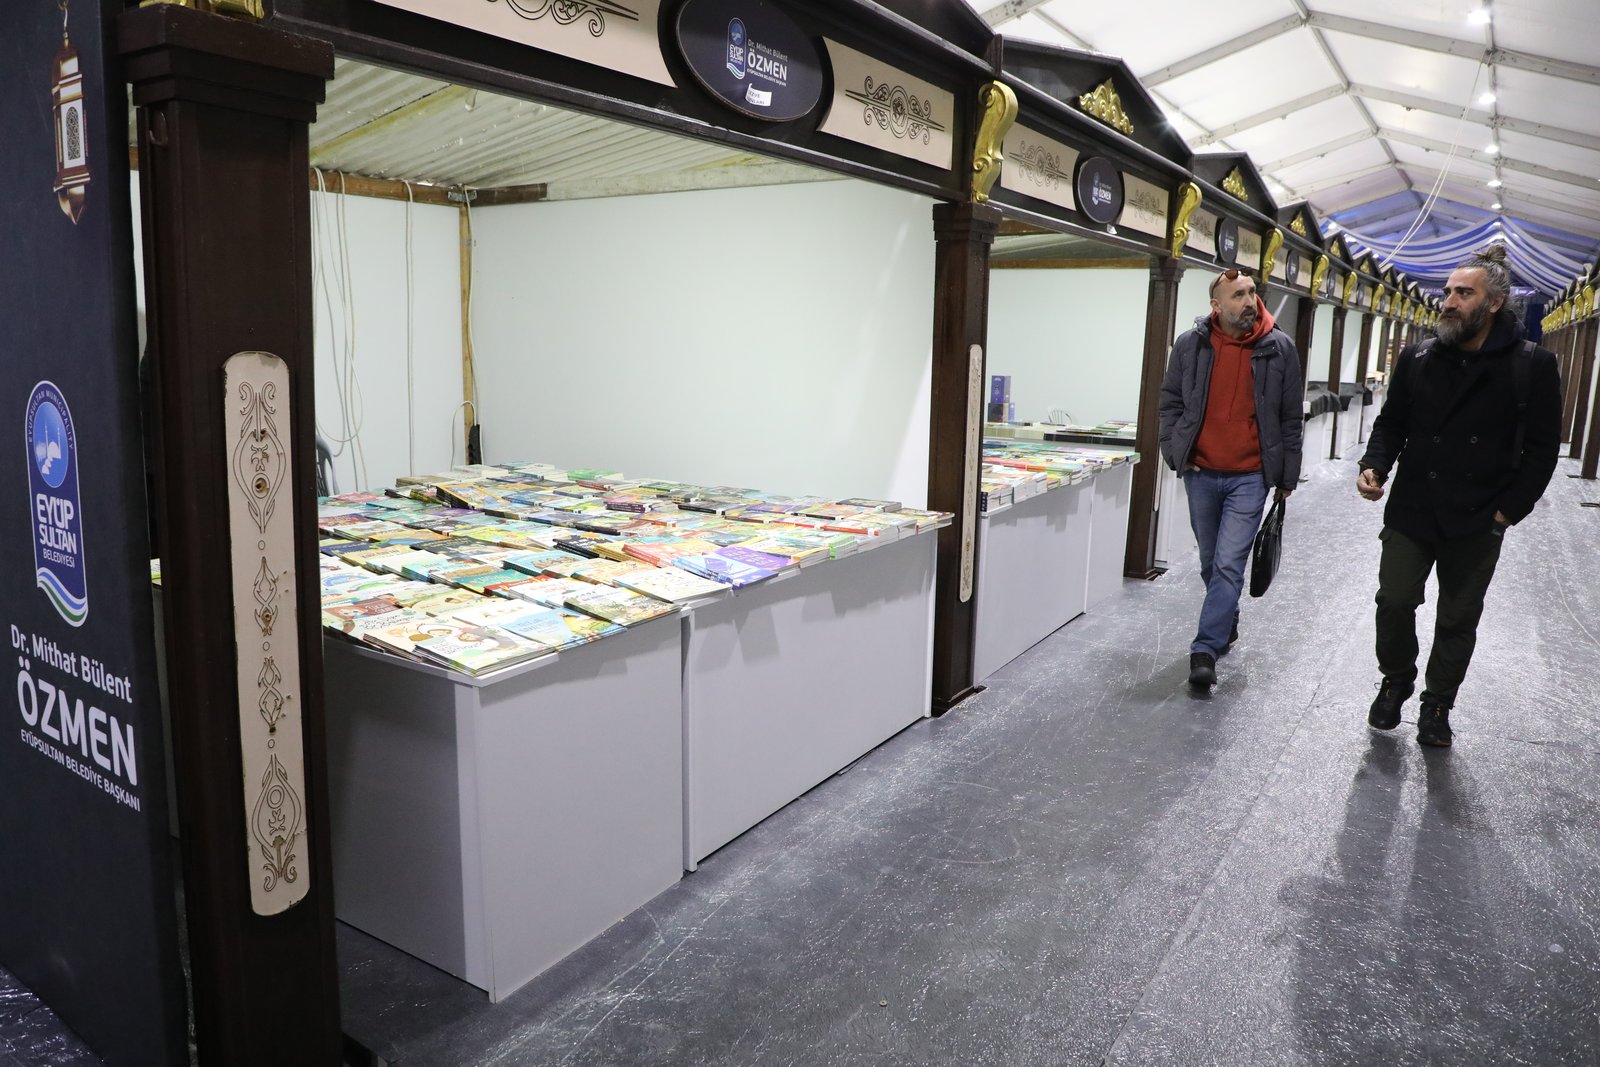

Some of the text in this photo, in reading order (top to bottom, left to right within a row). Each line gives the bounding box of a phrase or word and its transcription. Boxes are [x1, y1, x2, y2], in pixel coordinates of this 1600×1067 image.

[747, 48, 788, 81] ÖZMEN
[36, 493, 75, 530] EYÜP
[39, 523, 77, 555] SULTAN
[10, 623, 133, 704] Dr. Mithat Bülent
[17, 655, 138, 787] ÖZMEN
[20, 728, 141, 812] EYÜPSULTAN BELEDİYE BAŞKANI
